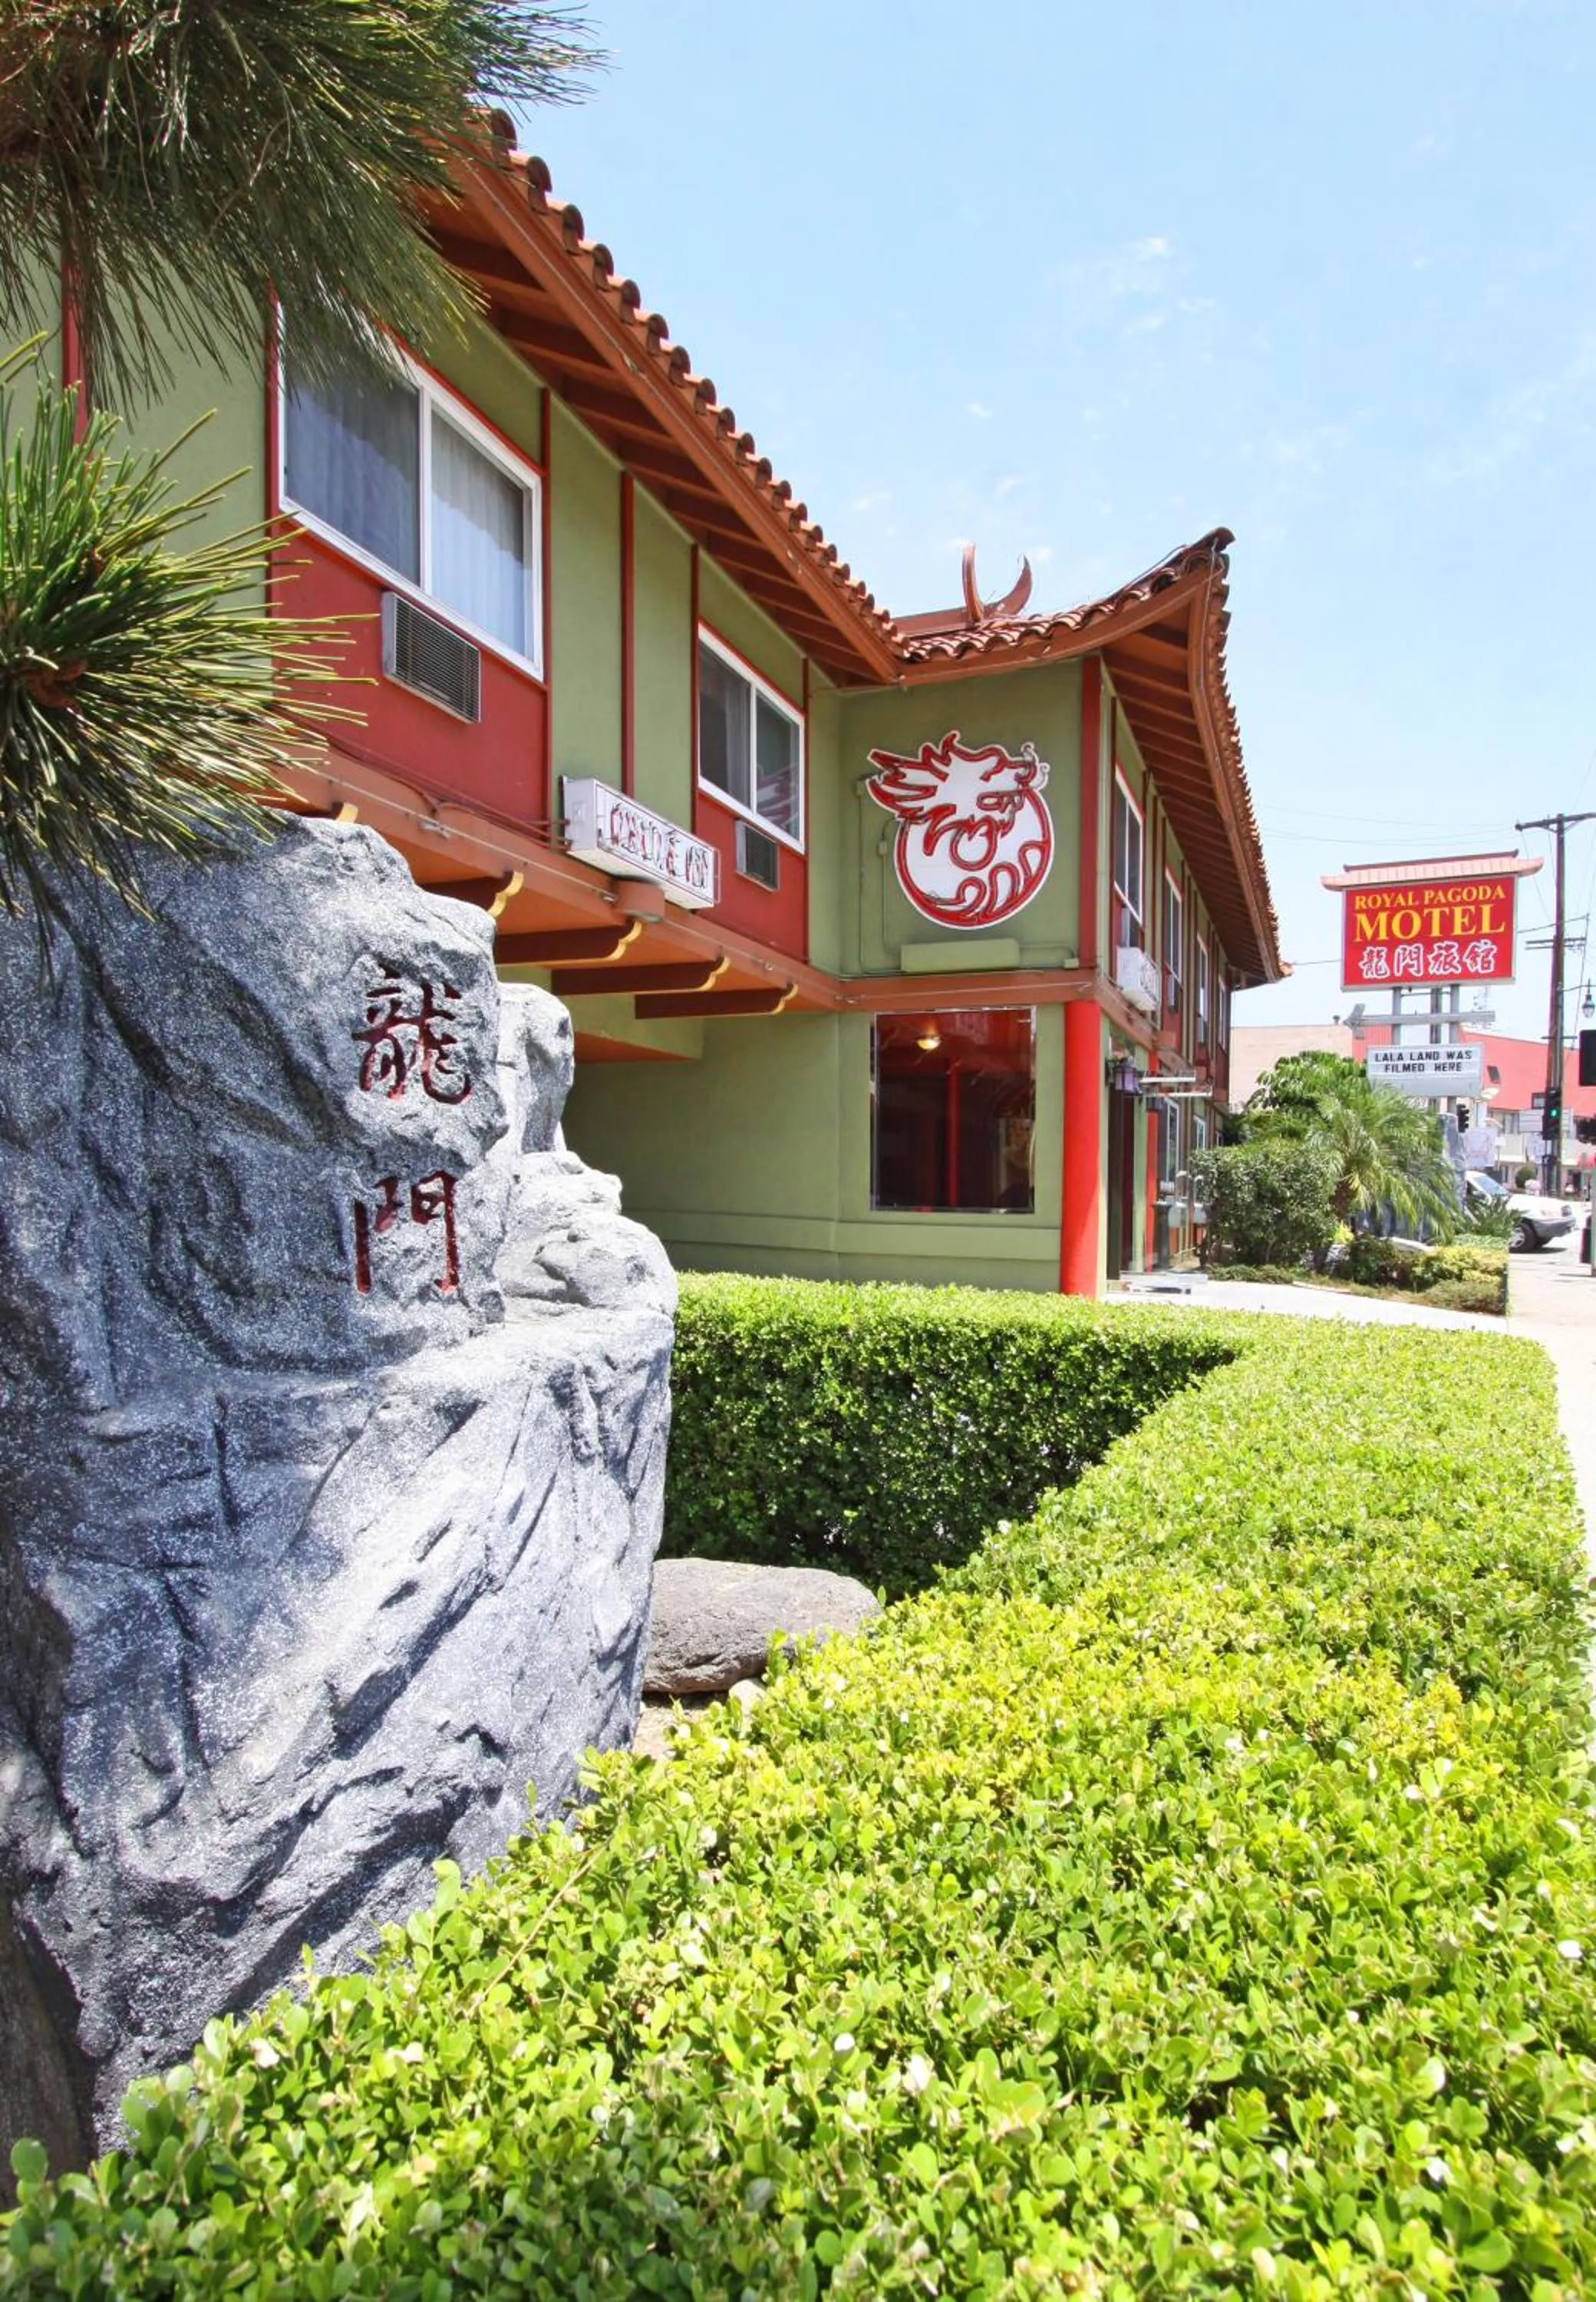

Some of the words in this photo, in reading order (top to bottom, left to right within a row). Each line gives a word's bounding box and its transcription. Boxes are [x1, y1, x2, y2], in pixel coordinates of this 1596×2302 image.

[1354, 891, 1419, 910] ROYAL
[1423, 885, 1506, 905] PAGODA
[1354, 903, 1506, 942] MOTEL
[1374, 1052, 1404, 1062] LALA
[1410, 1050, 1440, 1061] LAND
[1446, 1049, 1473, 1060] WAS
[1384, 1063, 1425, 1073] FILMED
[1434, 1061, 1463, 1072] HERE
